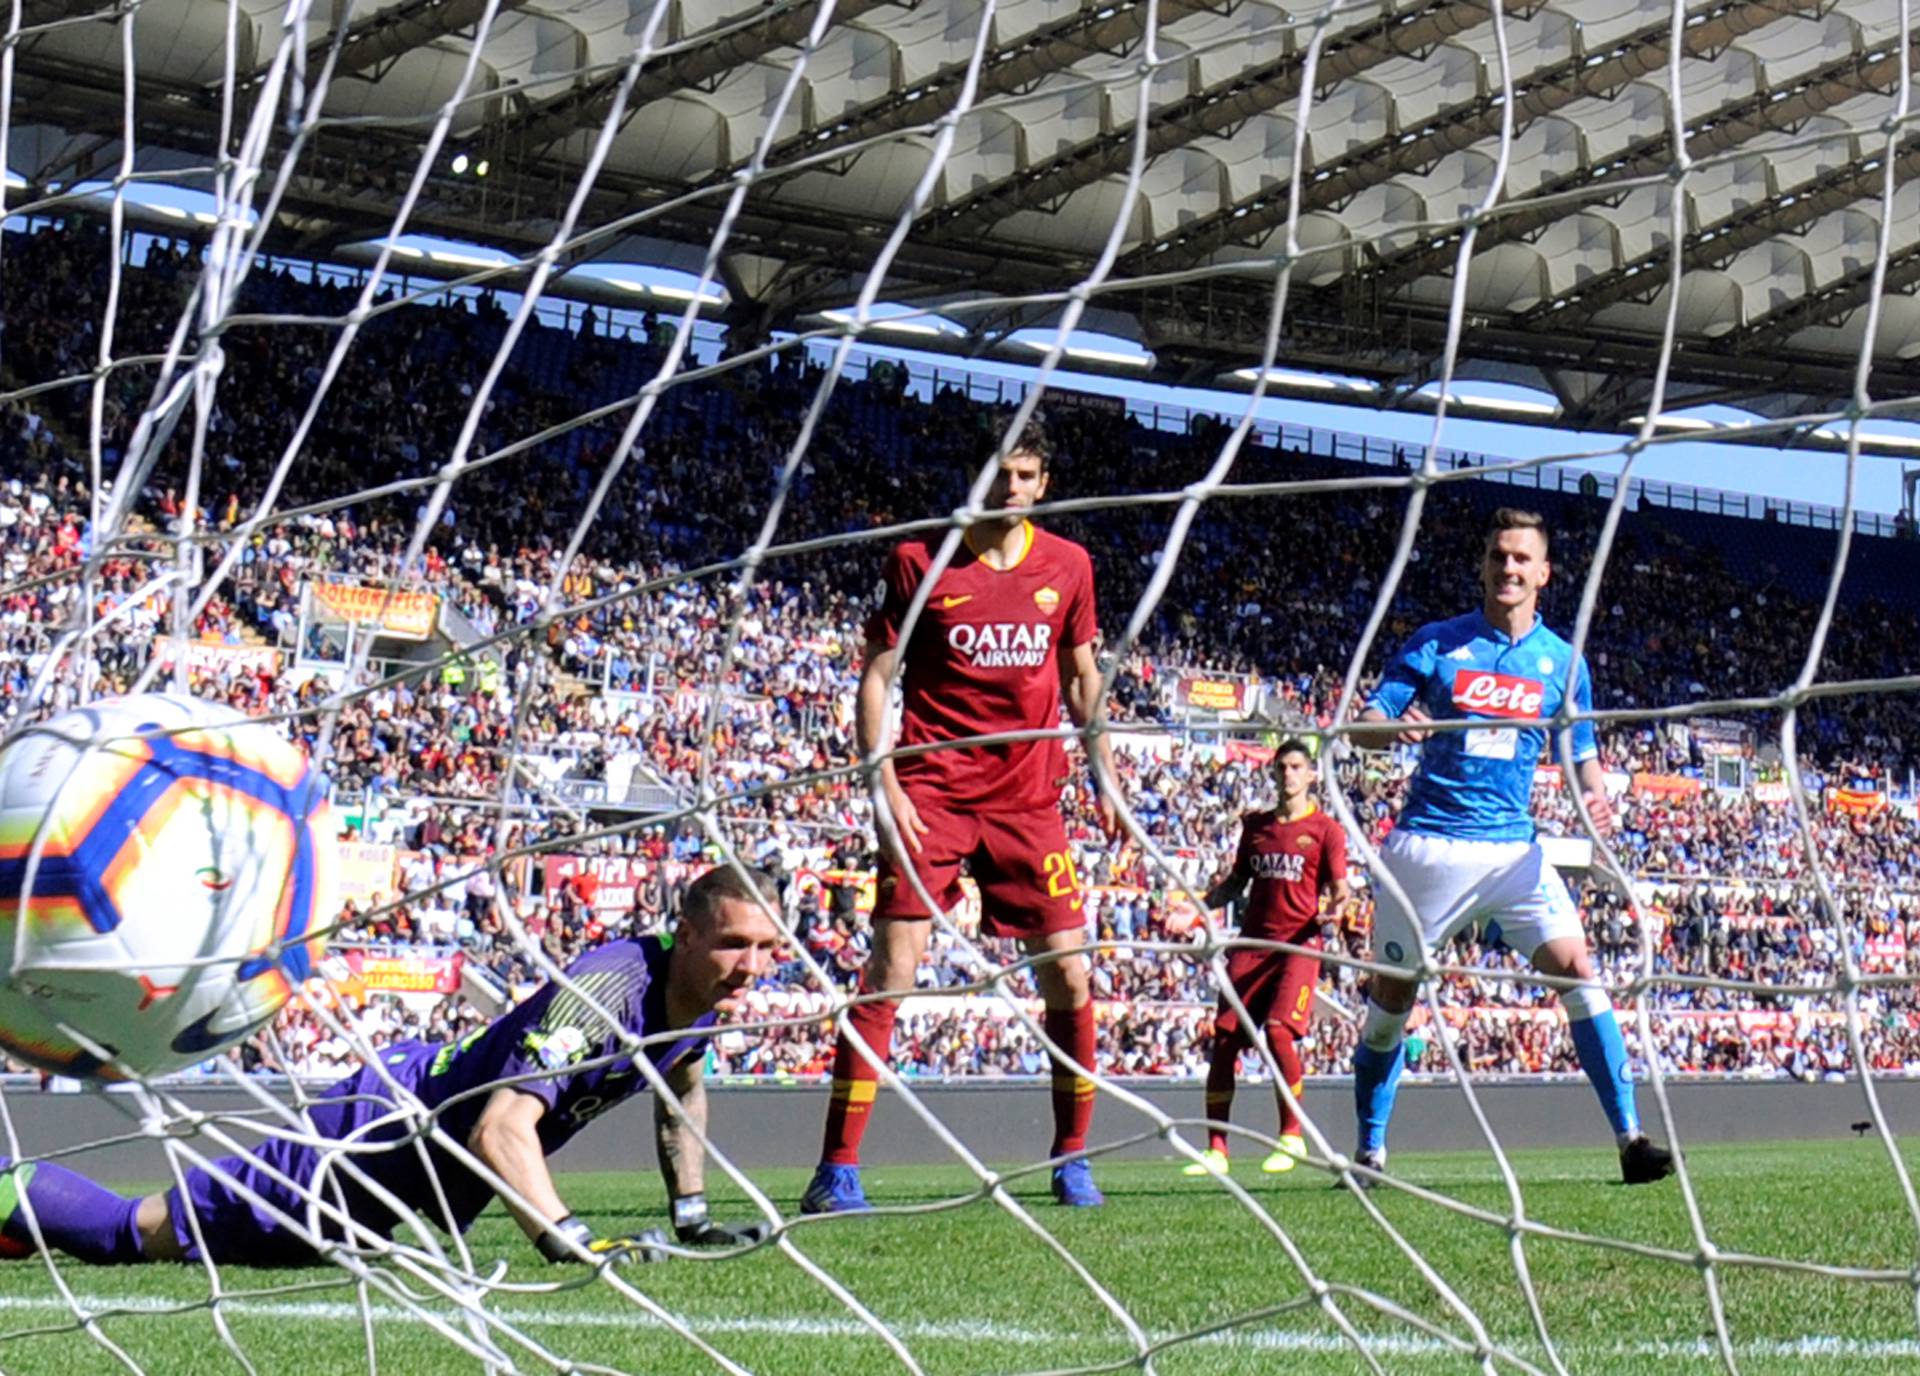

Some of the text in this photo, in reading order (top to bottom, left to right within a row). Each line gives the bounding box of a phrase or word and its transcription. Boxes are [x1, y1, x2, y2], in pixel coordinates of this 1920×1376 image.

[948, 624, 1053, 655] QATAR
[971, 650, 1046, 667] AIRWAYS
[1451, 675, 1543, 715] Lete
[1249, 853, 1306, 873] QATAR
